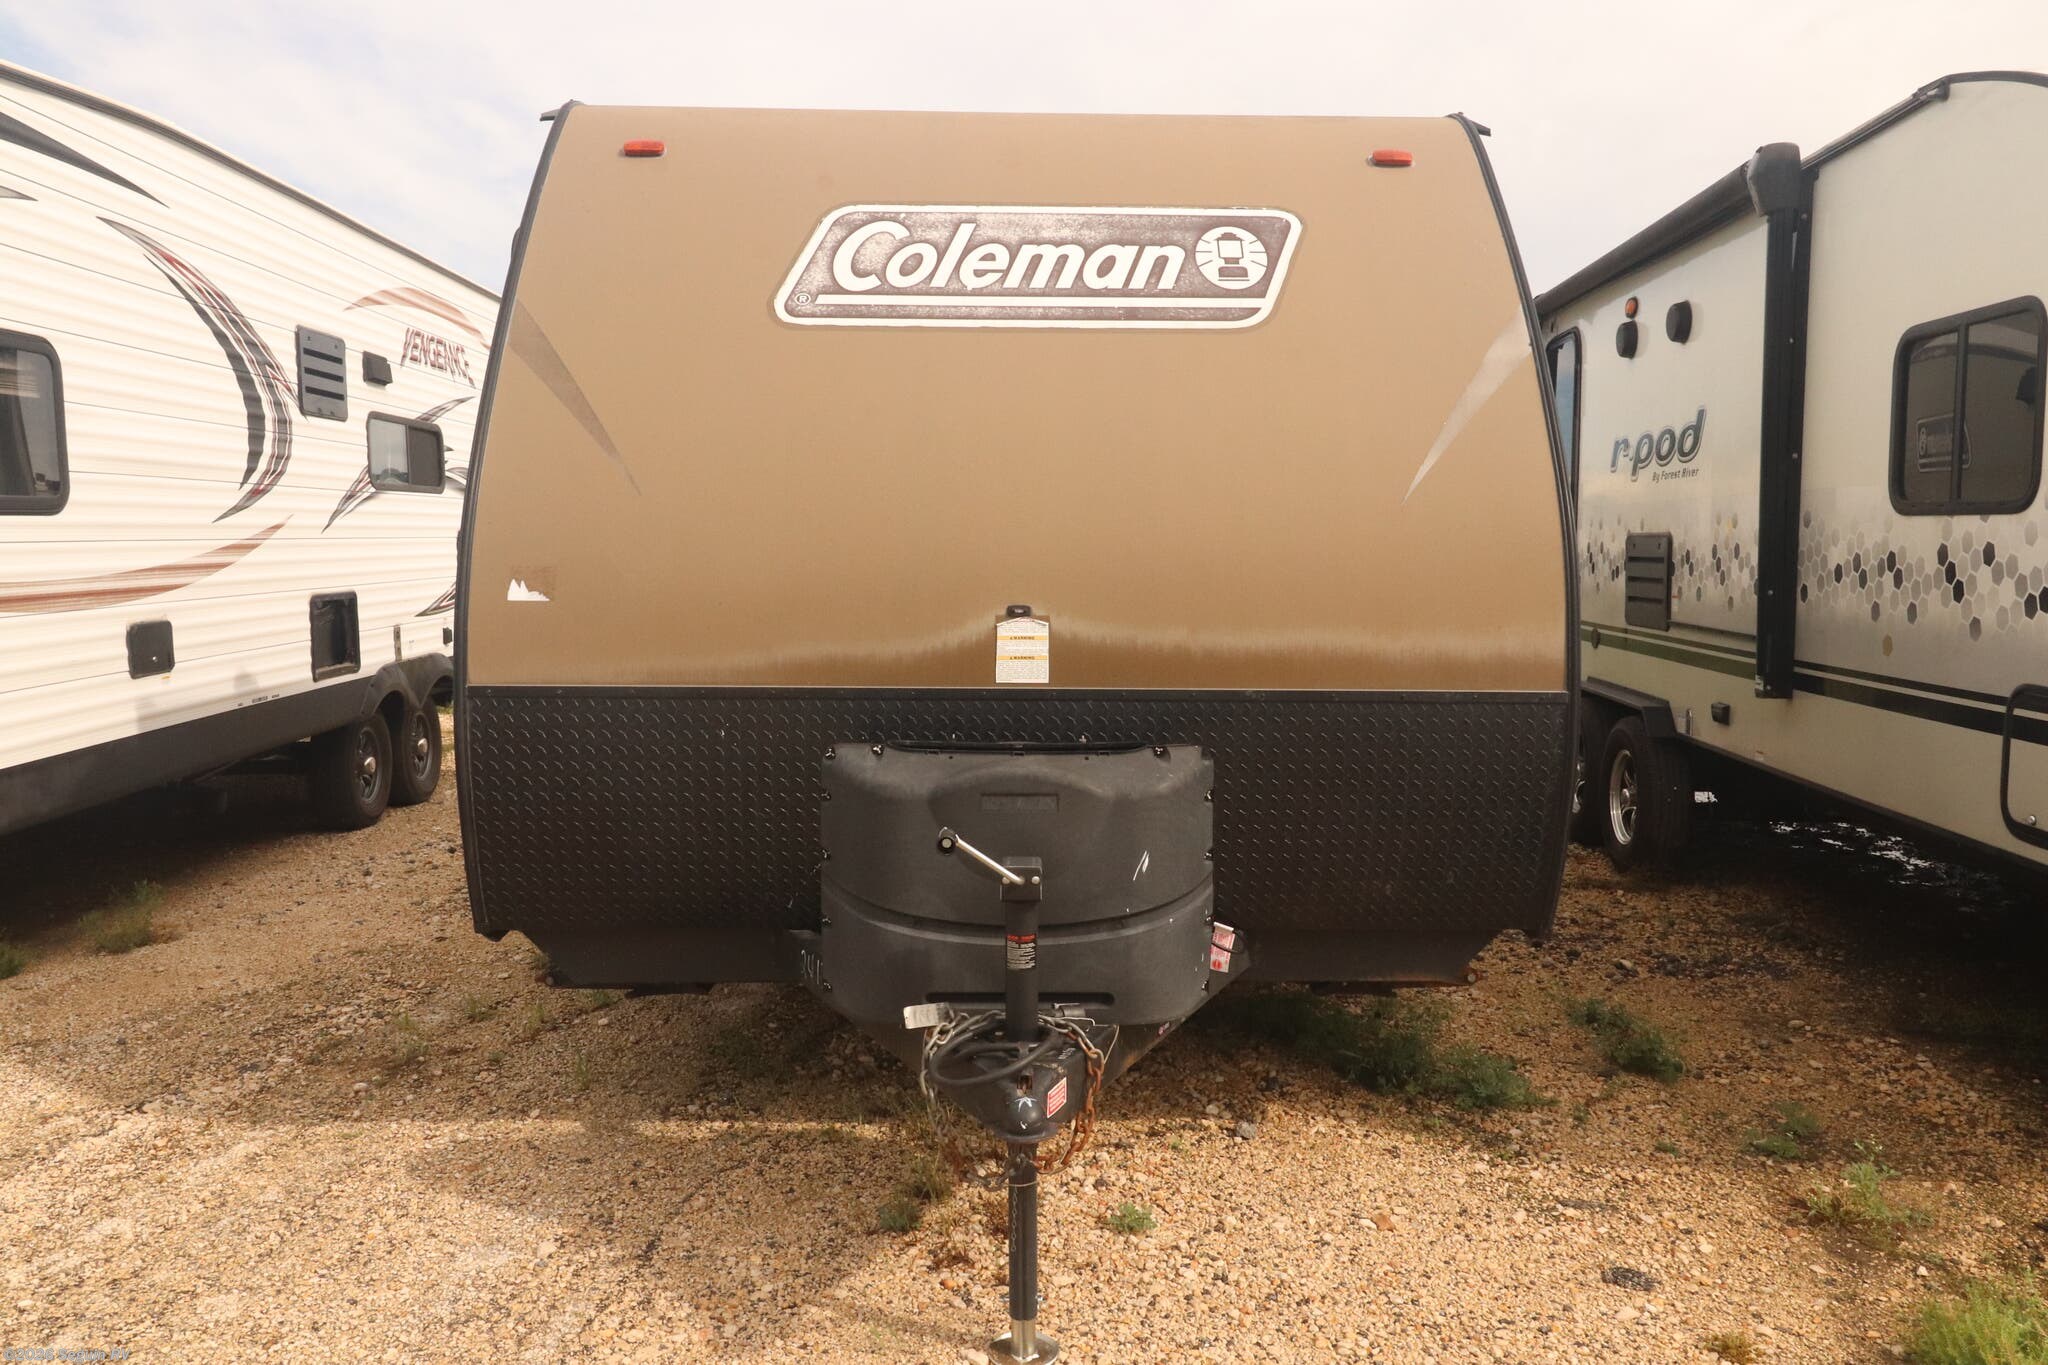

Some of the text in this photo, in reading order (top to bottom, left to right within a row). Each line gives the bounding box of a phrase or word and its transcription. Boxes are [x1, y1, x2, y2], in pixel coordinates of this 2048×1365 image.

[832, 220, 1187, 292] Coleman
[400, 327, 476, 389] VENGEANCE
[1661, 469, 1681, 480] Forest
[1681, 467, 1700, 479] River
